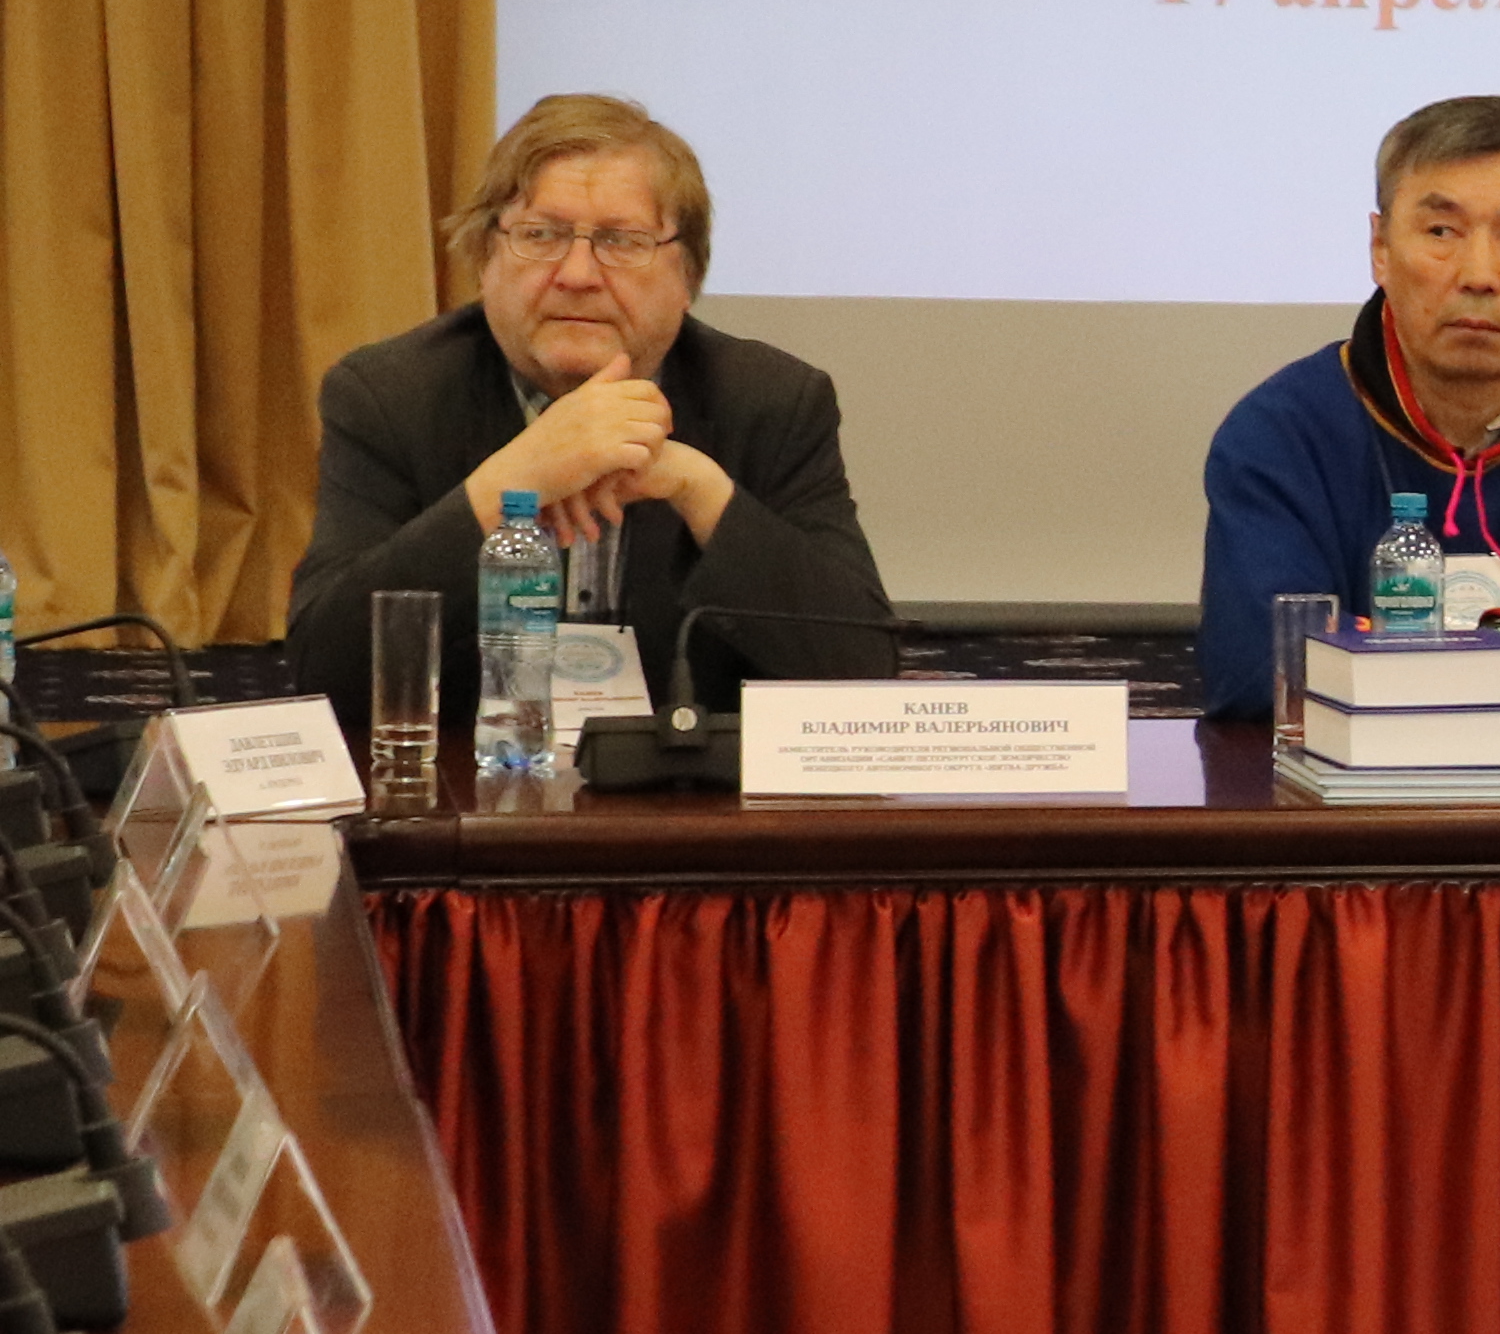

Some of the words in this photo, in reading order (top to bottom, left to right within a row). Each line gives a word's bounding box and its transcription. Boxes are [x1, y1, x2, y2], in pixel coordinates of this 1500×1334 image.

[904, 701, 969, 716] КАНЕВ
[801, 720, 910, 736] ВЛАДИМИР
[915, 720, 1070, 735] ВАЛЕРЬЯНОВИЧ
